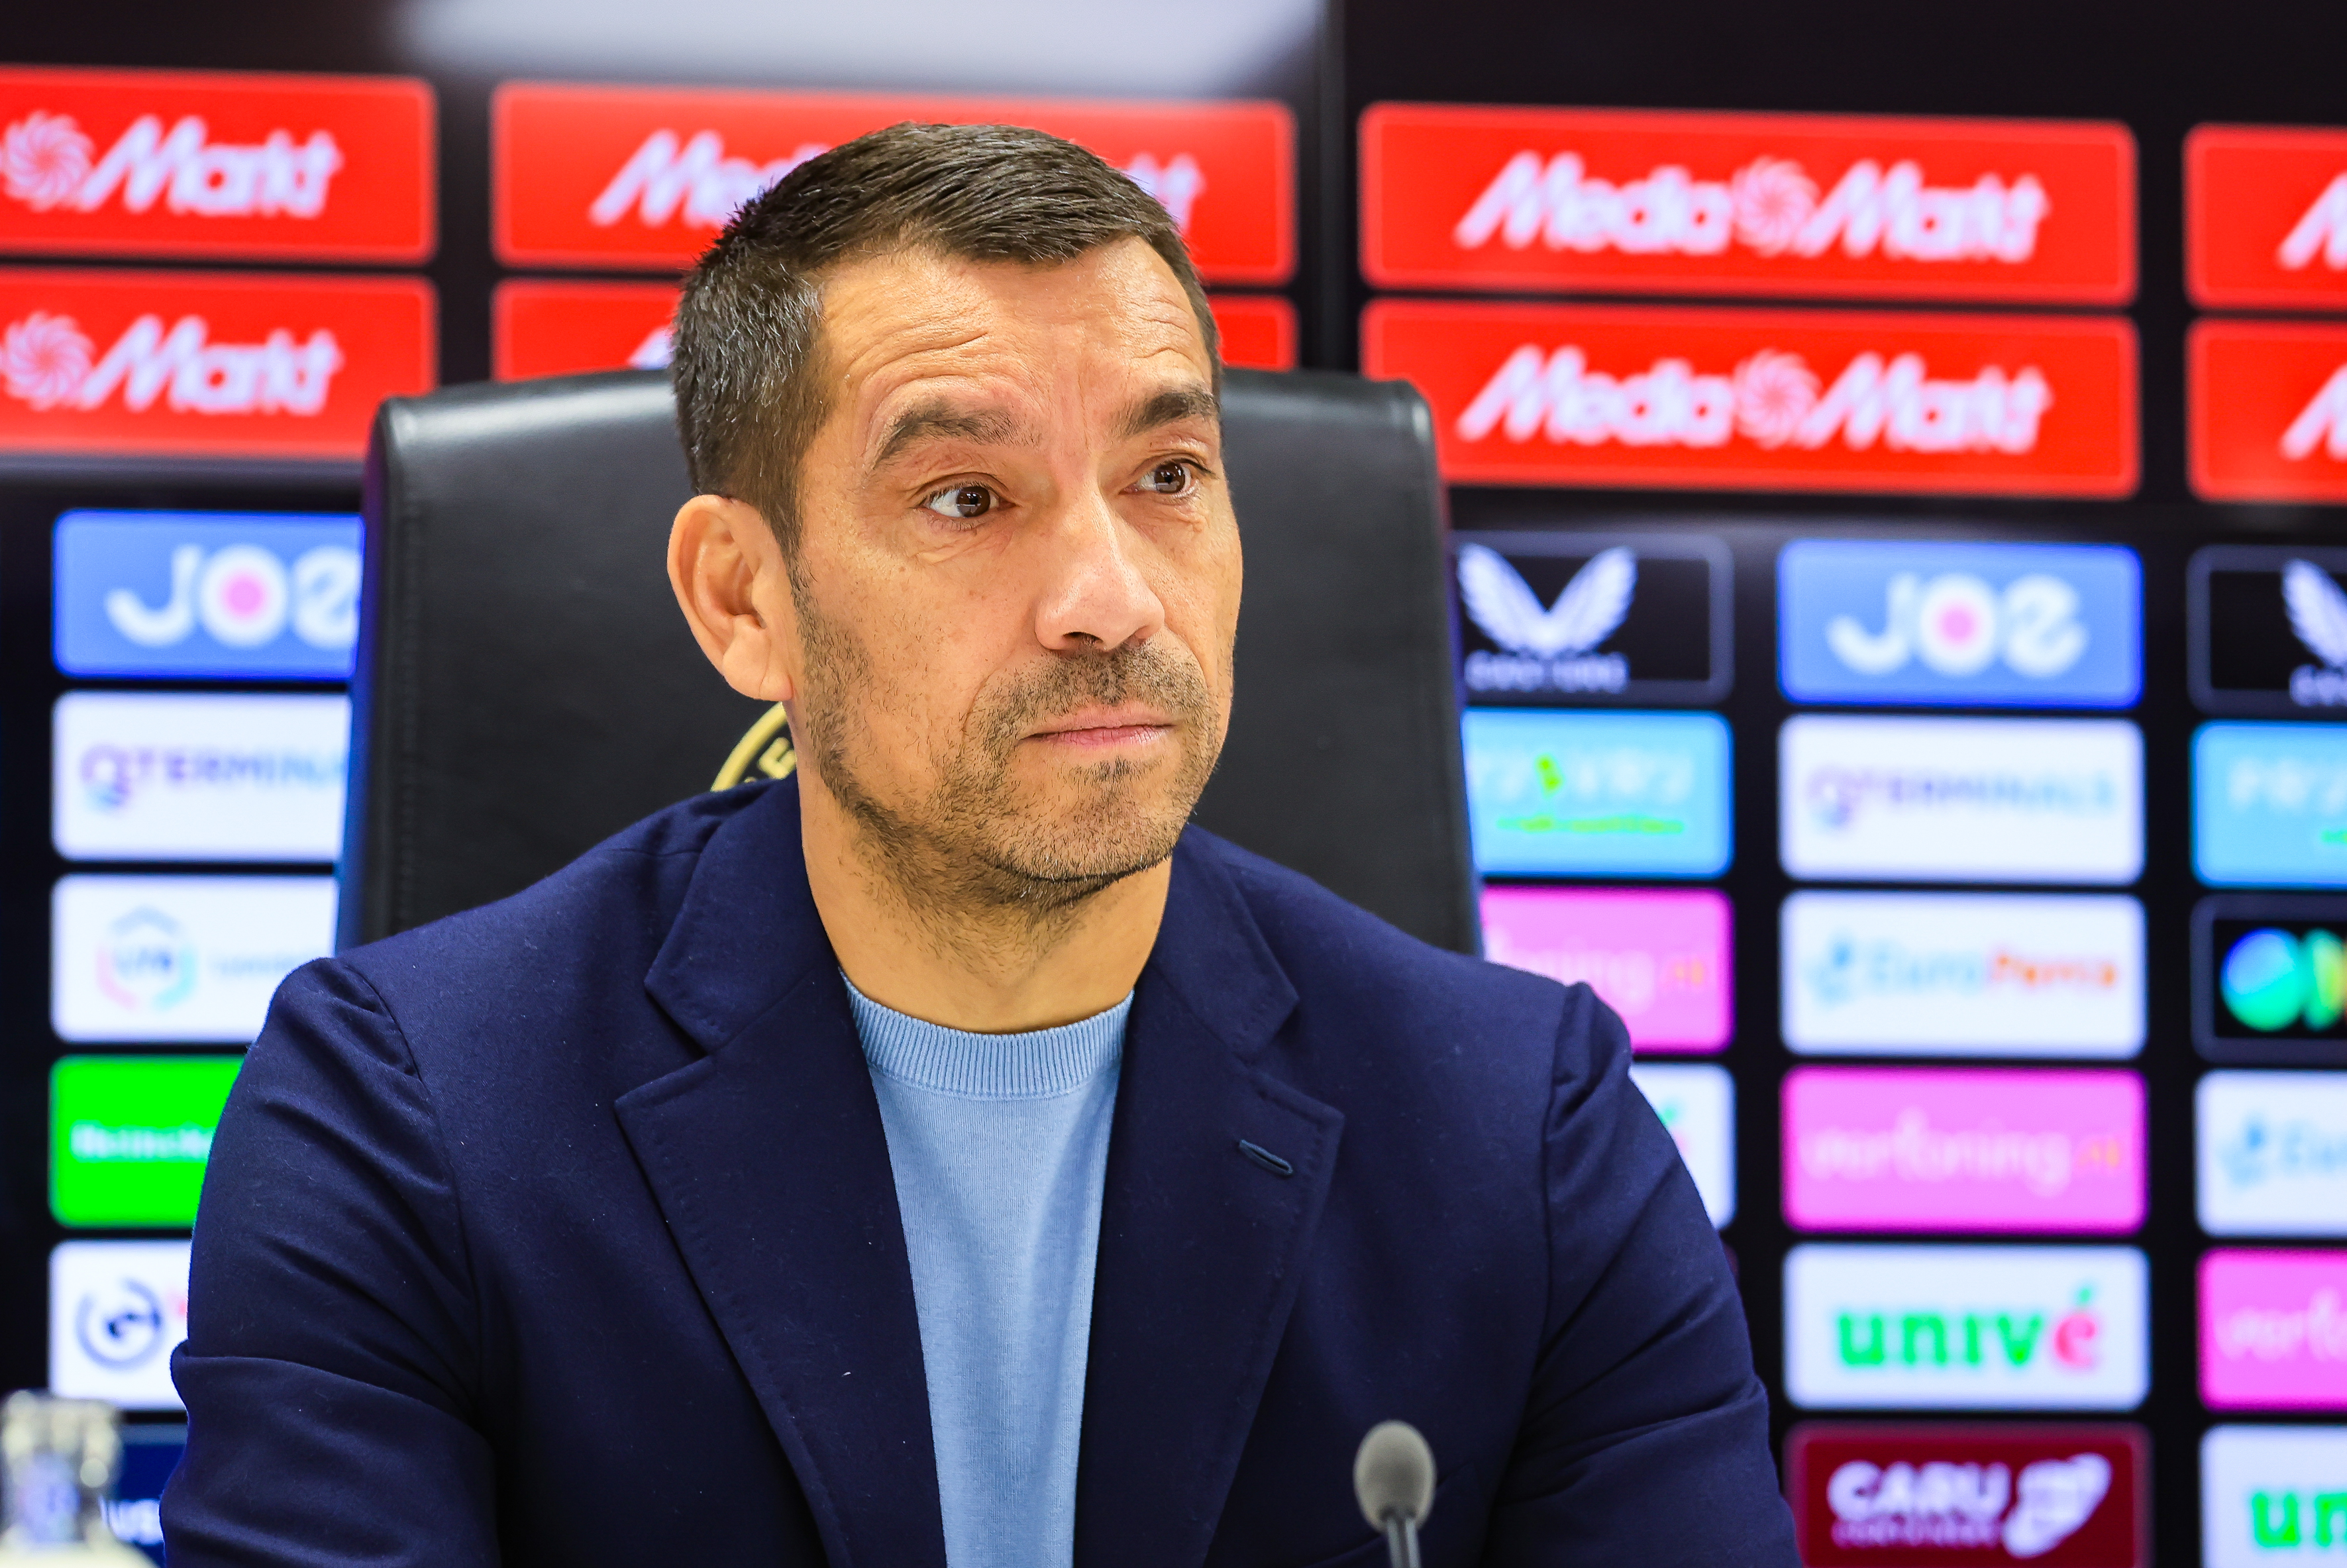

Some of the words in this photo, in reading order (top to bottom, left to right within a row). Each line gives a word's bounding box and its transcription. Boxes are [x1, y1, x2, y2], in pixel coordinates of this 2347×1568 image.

[77, 115, 343, 217] Markt
[77, 315, 344, 415] Markt
[1838, 1284, 2100, 1369] univé
[1827, 1460, 2012, 1525] CARU
